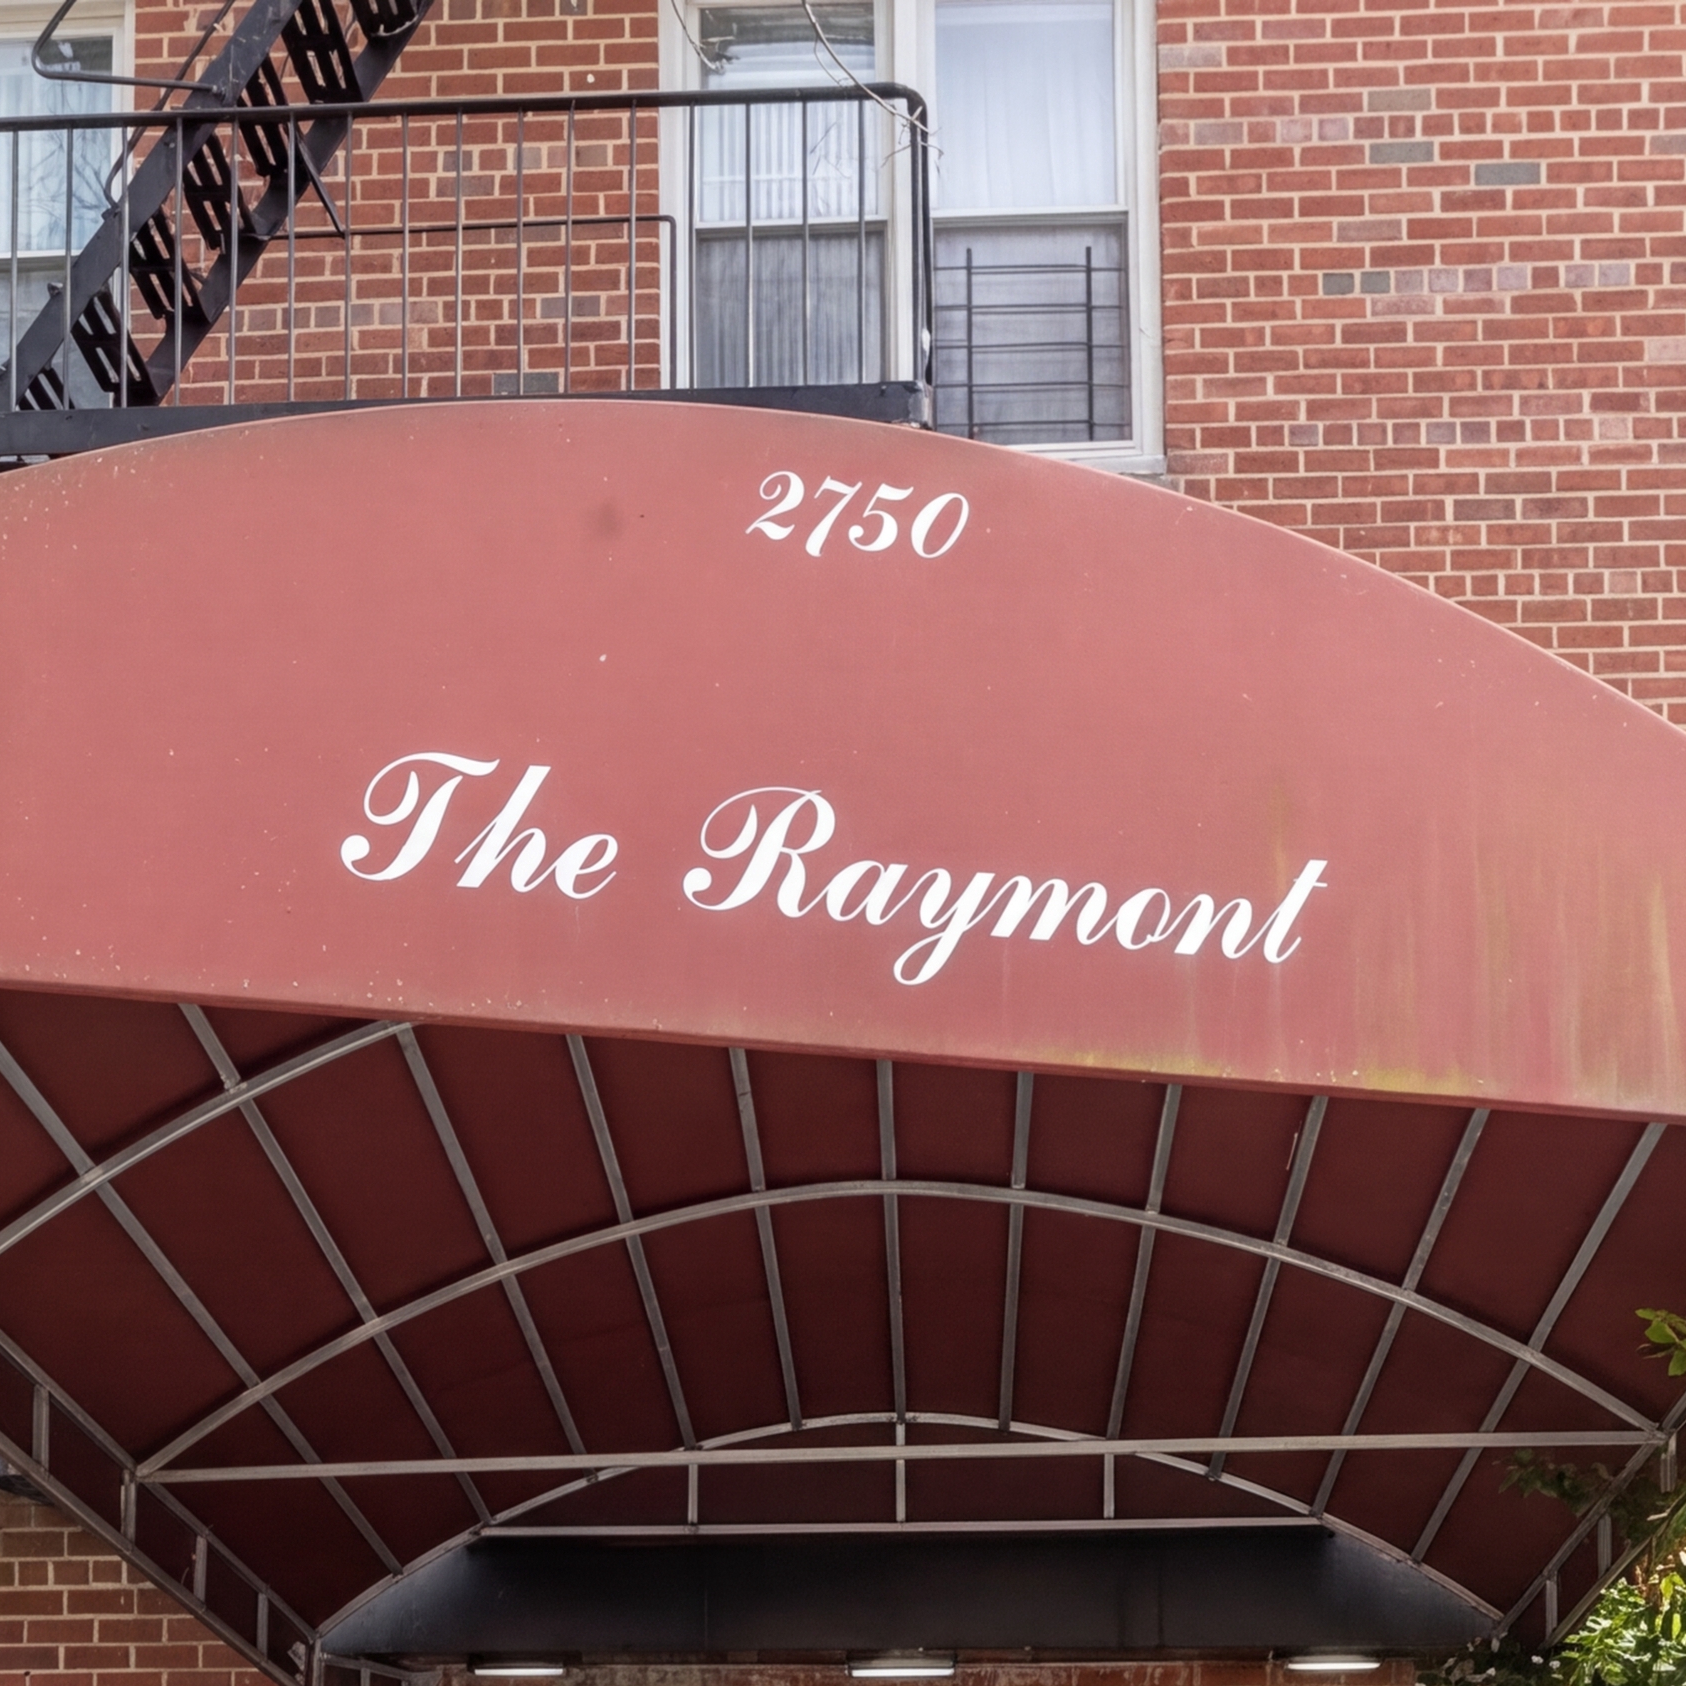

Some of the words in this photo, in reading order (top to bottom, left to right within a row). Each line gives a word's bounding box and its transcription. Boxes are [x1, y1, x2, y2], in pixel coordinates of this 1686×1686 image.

[745, 470, 970, 559] 2750
[340, 751, 619, 900] The
[682, 786, 1328, 986] Raymont
